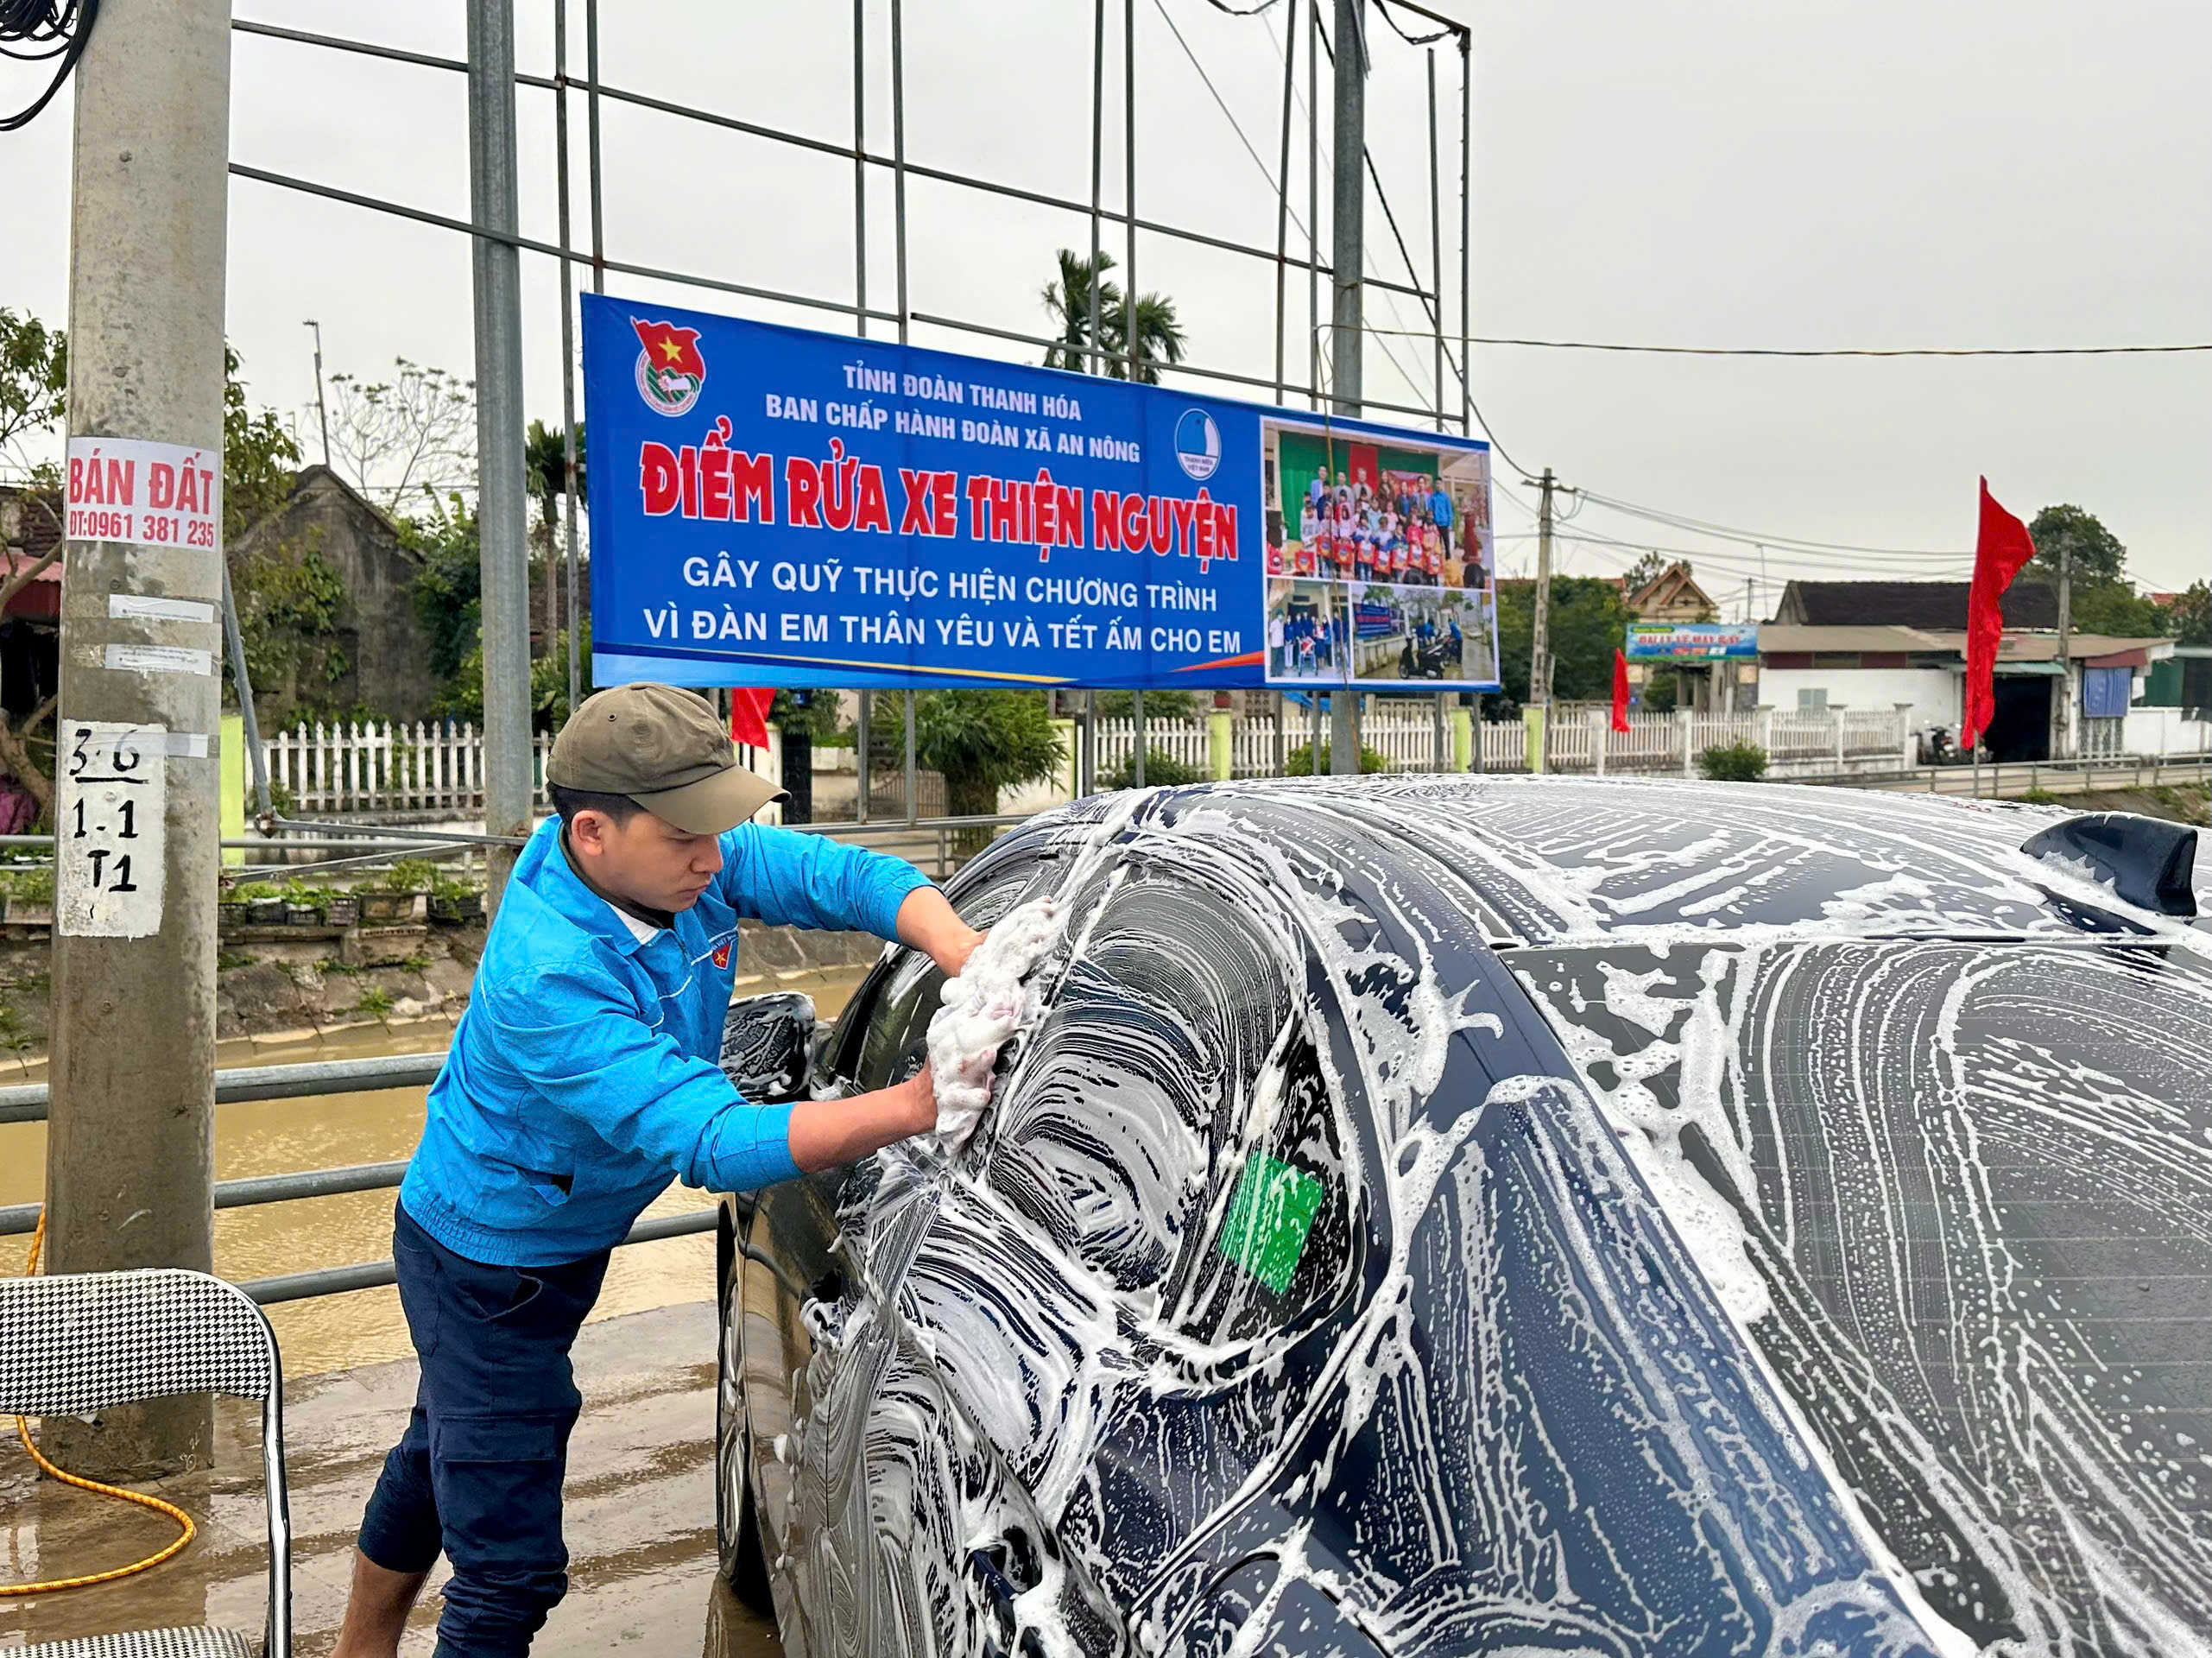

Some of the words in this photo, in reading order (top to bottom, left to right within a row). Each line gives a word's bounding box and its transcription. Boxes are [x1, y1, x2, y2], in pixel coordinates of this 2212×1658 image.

[843, 360, 896, 395] TỈNH
[903, 370, 964, 404] ĐOÀN
[970, 383, 1036, 414] THANH
[1043, 395, 1082, 421] HÓA
[766, 394, 818, 422] BAN
[825, 400, 888, 432] CHẤP
[895, 410, 956, 440] HÀNH
[962, 419, 1019, 448] ĐOÀN
[1025, 426, 1052, 452] XÃ
[1057, 433, 1084, 457] AN
[1090, 435, 1141, 463] NÔNG
[69, 447, 136, 506] BÁN
[148, 452, 213, 515] ĐẤT
[640, 414, 774, 524] ĐIỂM
[786, 437, 892, 534] RỬA
[899, 467, 958, 538] XE
[966, 467, 1084, 563] THIỆN
[1092, 486, 1238, 574] NGUYỆN
[69, 510, 134, 539] ĐT:0961
[142, 515, 179, 543] 381
[186, 520, 214, 547] 235
[683, 551, 760, 589] GÂY
[772, 558, 843, 593] QUỸ
[853, 566, 939, 602] THỰC
[949, 567, 1016, 606] HIỆN
[1026, 577, 1138, 608] CHƯƠNG
[1146, 579, 1217, 611] TRÌNH
[642, 601, 679, 639] VÌ
[692, 604, 768, 641] ĐÀN
[781, 613, 829, 642] EM
[839, 610, 926, 645] THÂN
[936, 613, 994, 647] YÊU
[1003, 615, 1040, 648] VÀ
[1047, 614, 1098, 649] TẾT
[1105, 615, 1142, 650] ẤM
[1150, 627, 1202, 653] CHO
[1209, 630, 1241, 653] EM
[87, 850, 136, 892] T1
